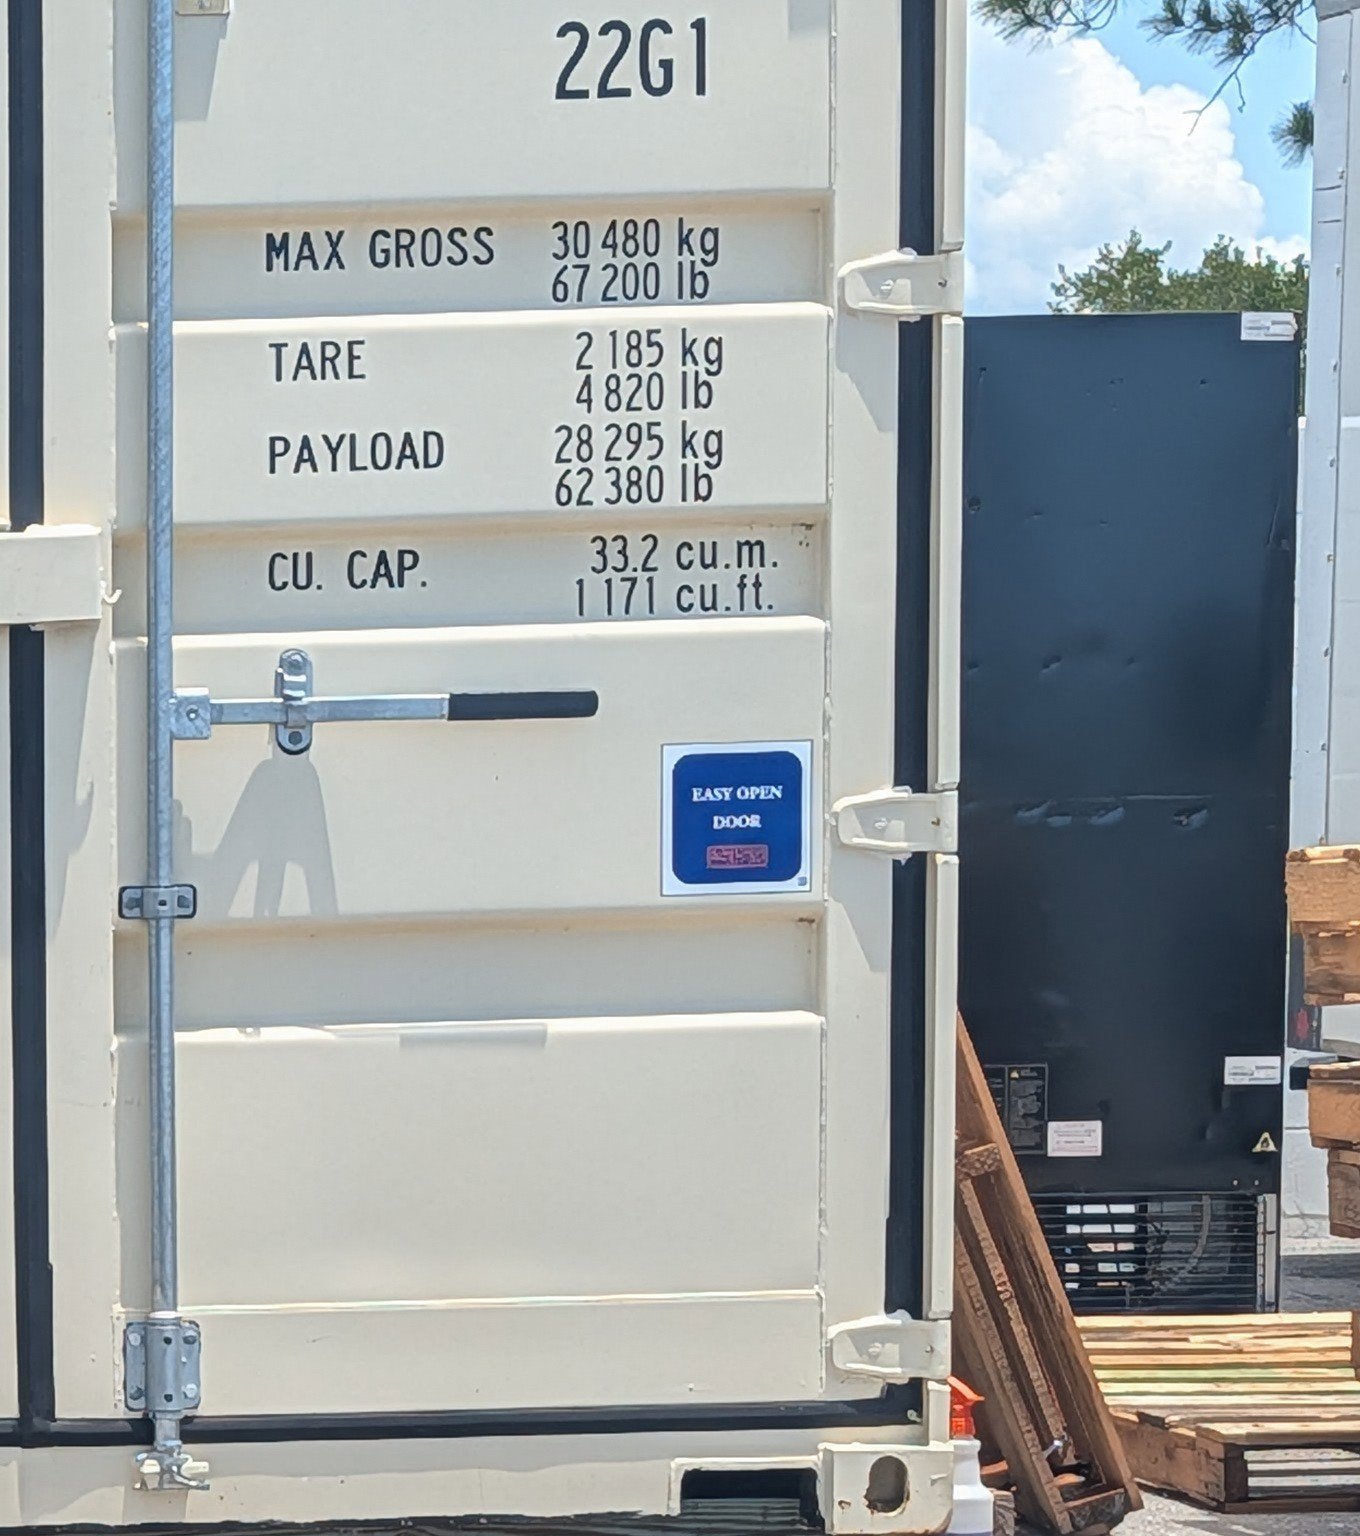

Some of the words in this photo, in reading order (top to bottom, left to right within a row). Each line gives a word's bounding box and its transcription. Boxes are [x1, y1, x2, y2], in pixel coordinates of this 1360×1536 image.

[555, 17, 706, 100] 22G1
[265, 230, 346, 273] MAX
[368, 226, 495, 269] GROSS
[677, 216, 720, 269] kg
[677, 259, 713, 300] lb
[268, 339, 366, 382] TARE
[681, 327, 723, 380] kg
[681, 369, 716, 410] lb
[268, 430, 444, 475] PAYLOAD
[681, 420, 723, 472] kg
[681, 462, 716, 503] lb
[268, 551, 323, 592] CU.
[346, 549, 427, 590] CAP.
[590, 533, 659, 575] 33.2
[675, 539, 778, 571] cu.m.
[676, 574, 774, 613] cu.ft.
[691, 786, 732, 802] EASY
[736, 785, 784, 801] OPEN
[712, 813, 762, 830] DOOR
